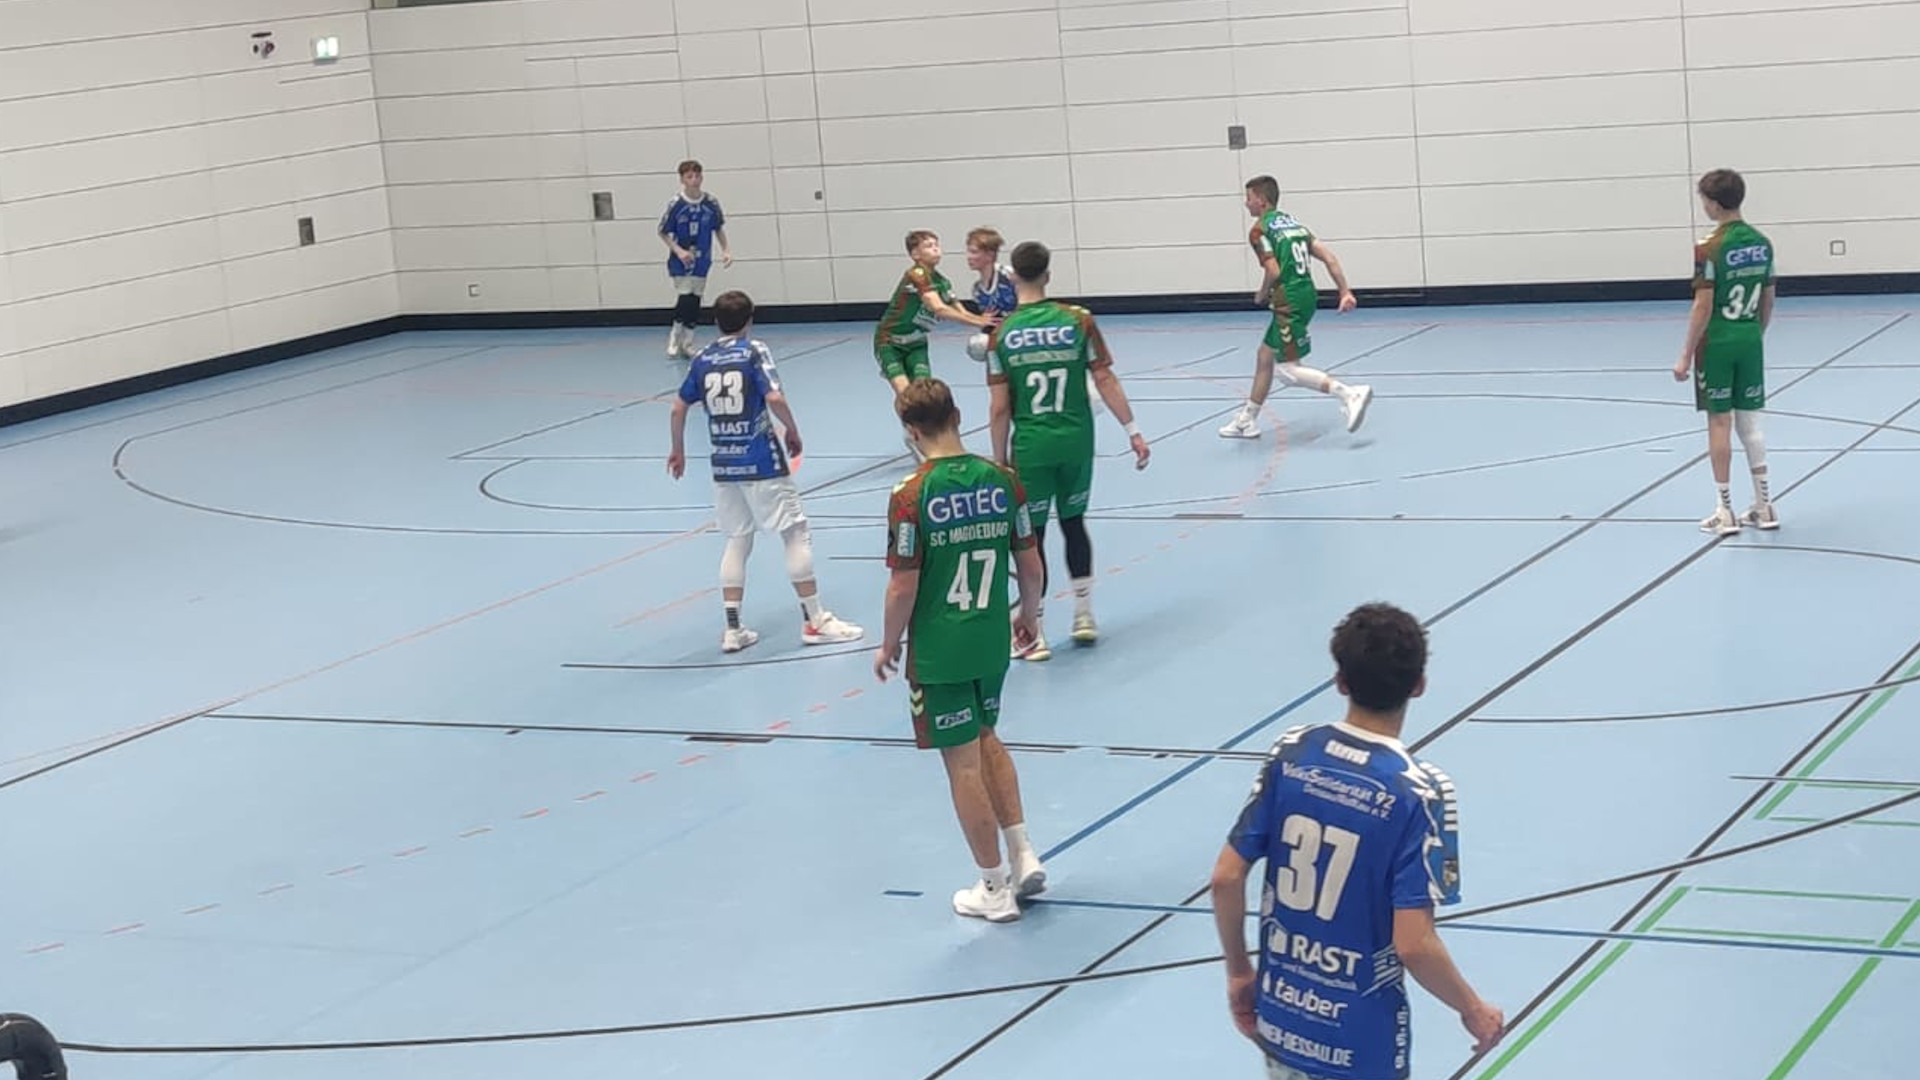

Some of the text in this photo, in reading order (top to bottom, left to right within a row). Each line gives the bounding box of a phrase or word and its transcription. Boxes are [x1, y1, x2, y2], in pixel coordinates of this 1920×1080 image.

[1004, 325, 1075, 349] GETEC
[704, 370, 743, 415] 23
[1026, 368, 1068, 415] 27
[927, 487, 1008, 523] GETEC
[929, 531, 947, 547] SC
[946, 548, 997, 611] 47
[1374, 790, 1397, 811] 92
[1276, 814, 1361, 921] 37
[1291, 934, 1363, 977] RAST
[1274, 976, 1349, 1018] tauber
